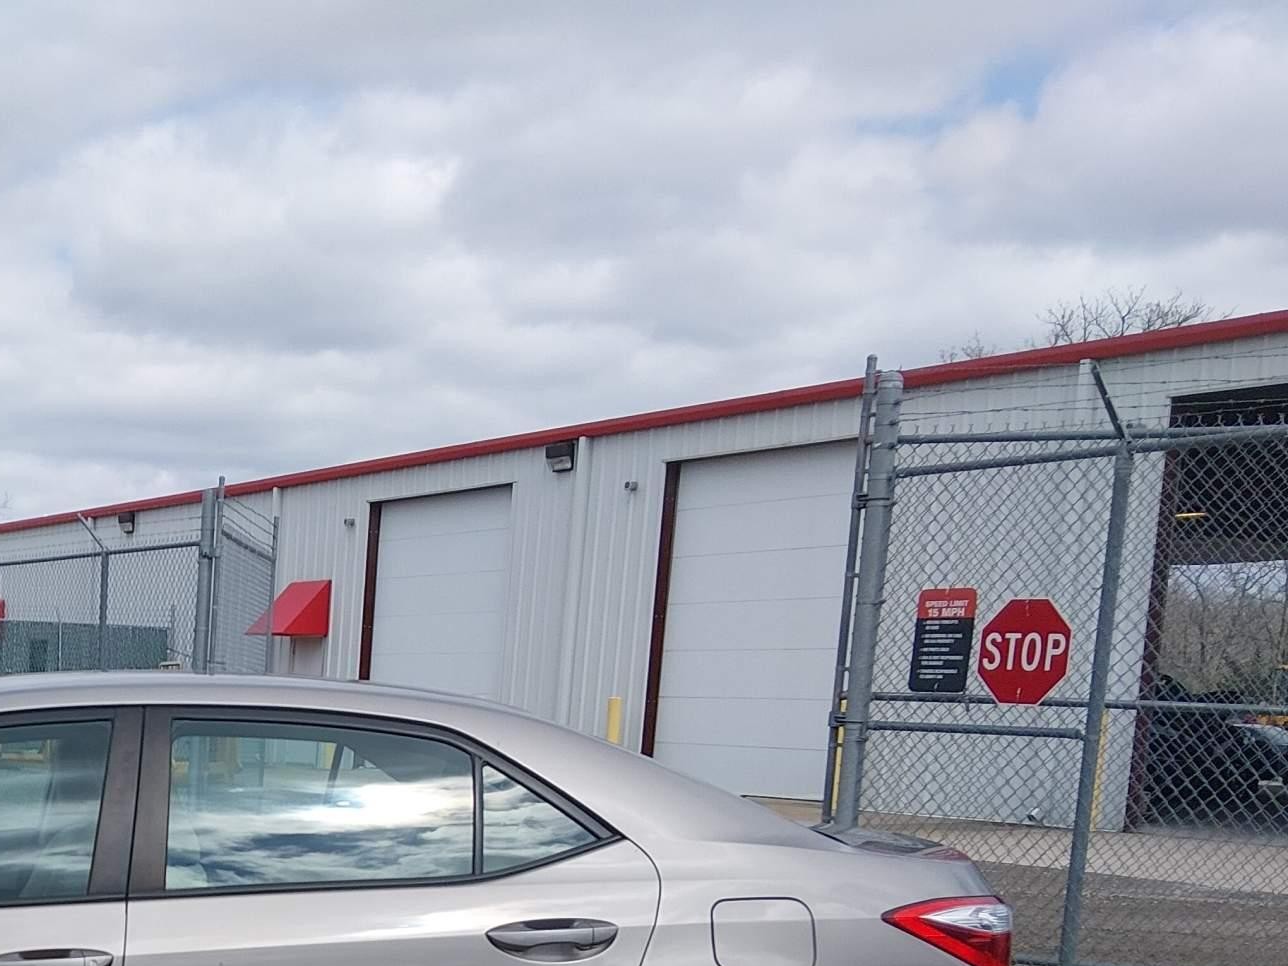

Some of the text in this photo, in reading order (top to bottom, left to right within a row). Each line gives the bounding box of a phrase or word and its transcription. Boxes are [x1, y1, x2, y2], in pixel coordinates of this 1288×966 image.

[928, 607, 965, 617] 15 MPH
[982, 632, 1066, 672] STOP
